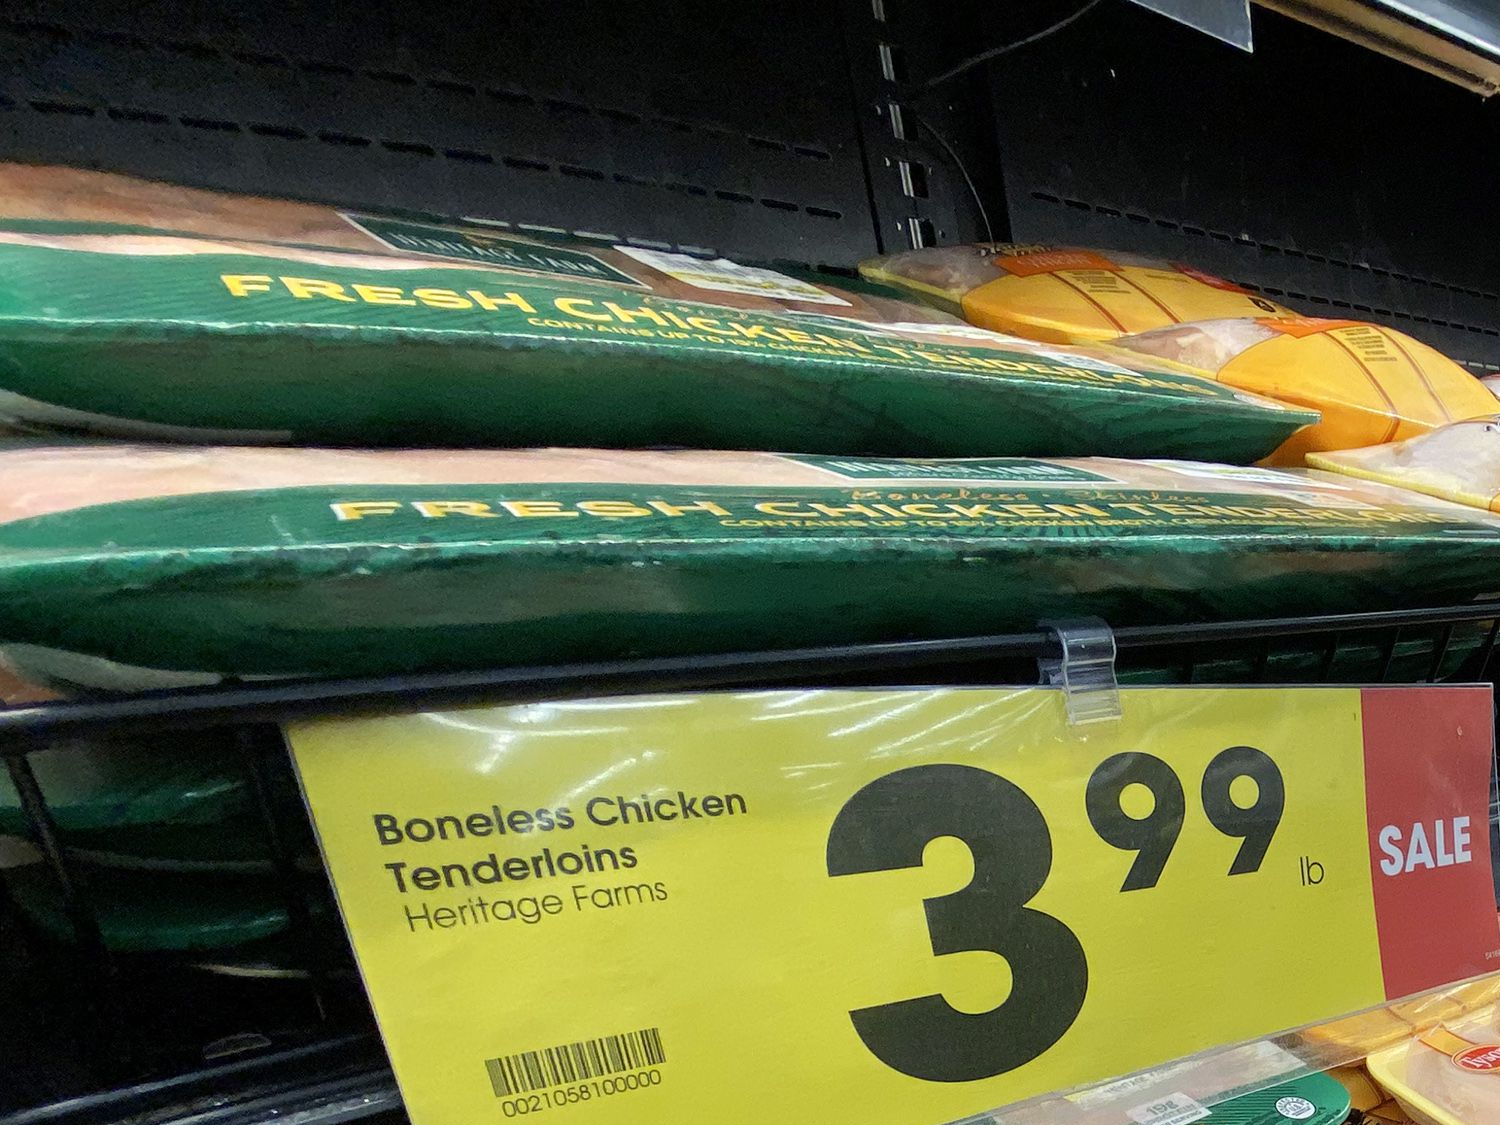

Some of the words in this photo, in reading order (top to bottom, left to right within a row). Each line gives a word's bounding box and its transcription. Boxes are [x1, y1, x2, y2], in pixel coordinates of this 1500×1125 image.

[220, 273, 538, 314] FRESH
[553, 296, 871, 354] CHICKEN
[527, 317, 656, 338] CONTAINS
[656, 330, 688, 341] UP
[329, 499, 734, 522] FRESH
[754, 501, 1107, 521] CHICKEN
[719, 519, 869, 529] CONTAINS
[373, 804, 575, 846] Boneless
[585, 789, 748, 827] Chicken
[385, 841, 638, 894] Tenderloins
[1300, 855, 1326, 887] lb
[1377, 816, 1474, 878] SALE
[404, 890, 564, 933] Heritage
[572, 876, 669, 913] Farms
[502, 1068, 662, 1118] 0021058100000
